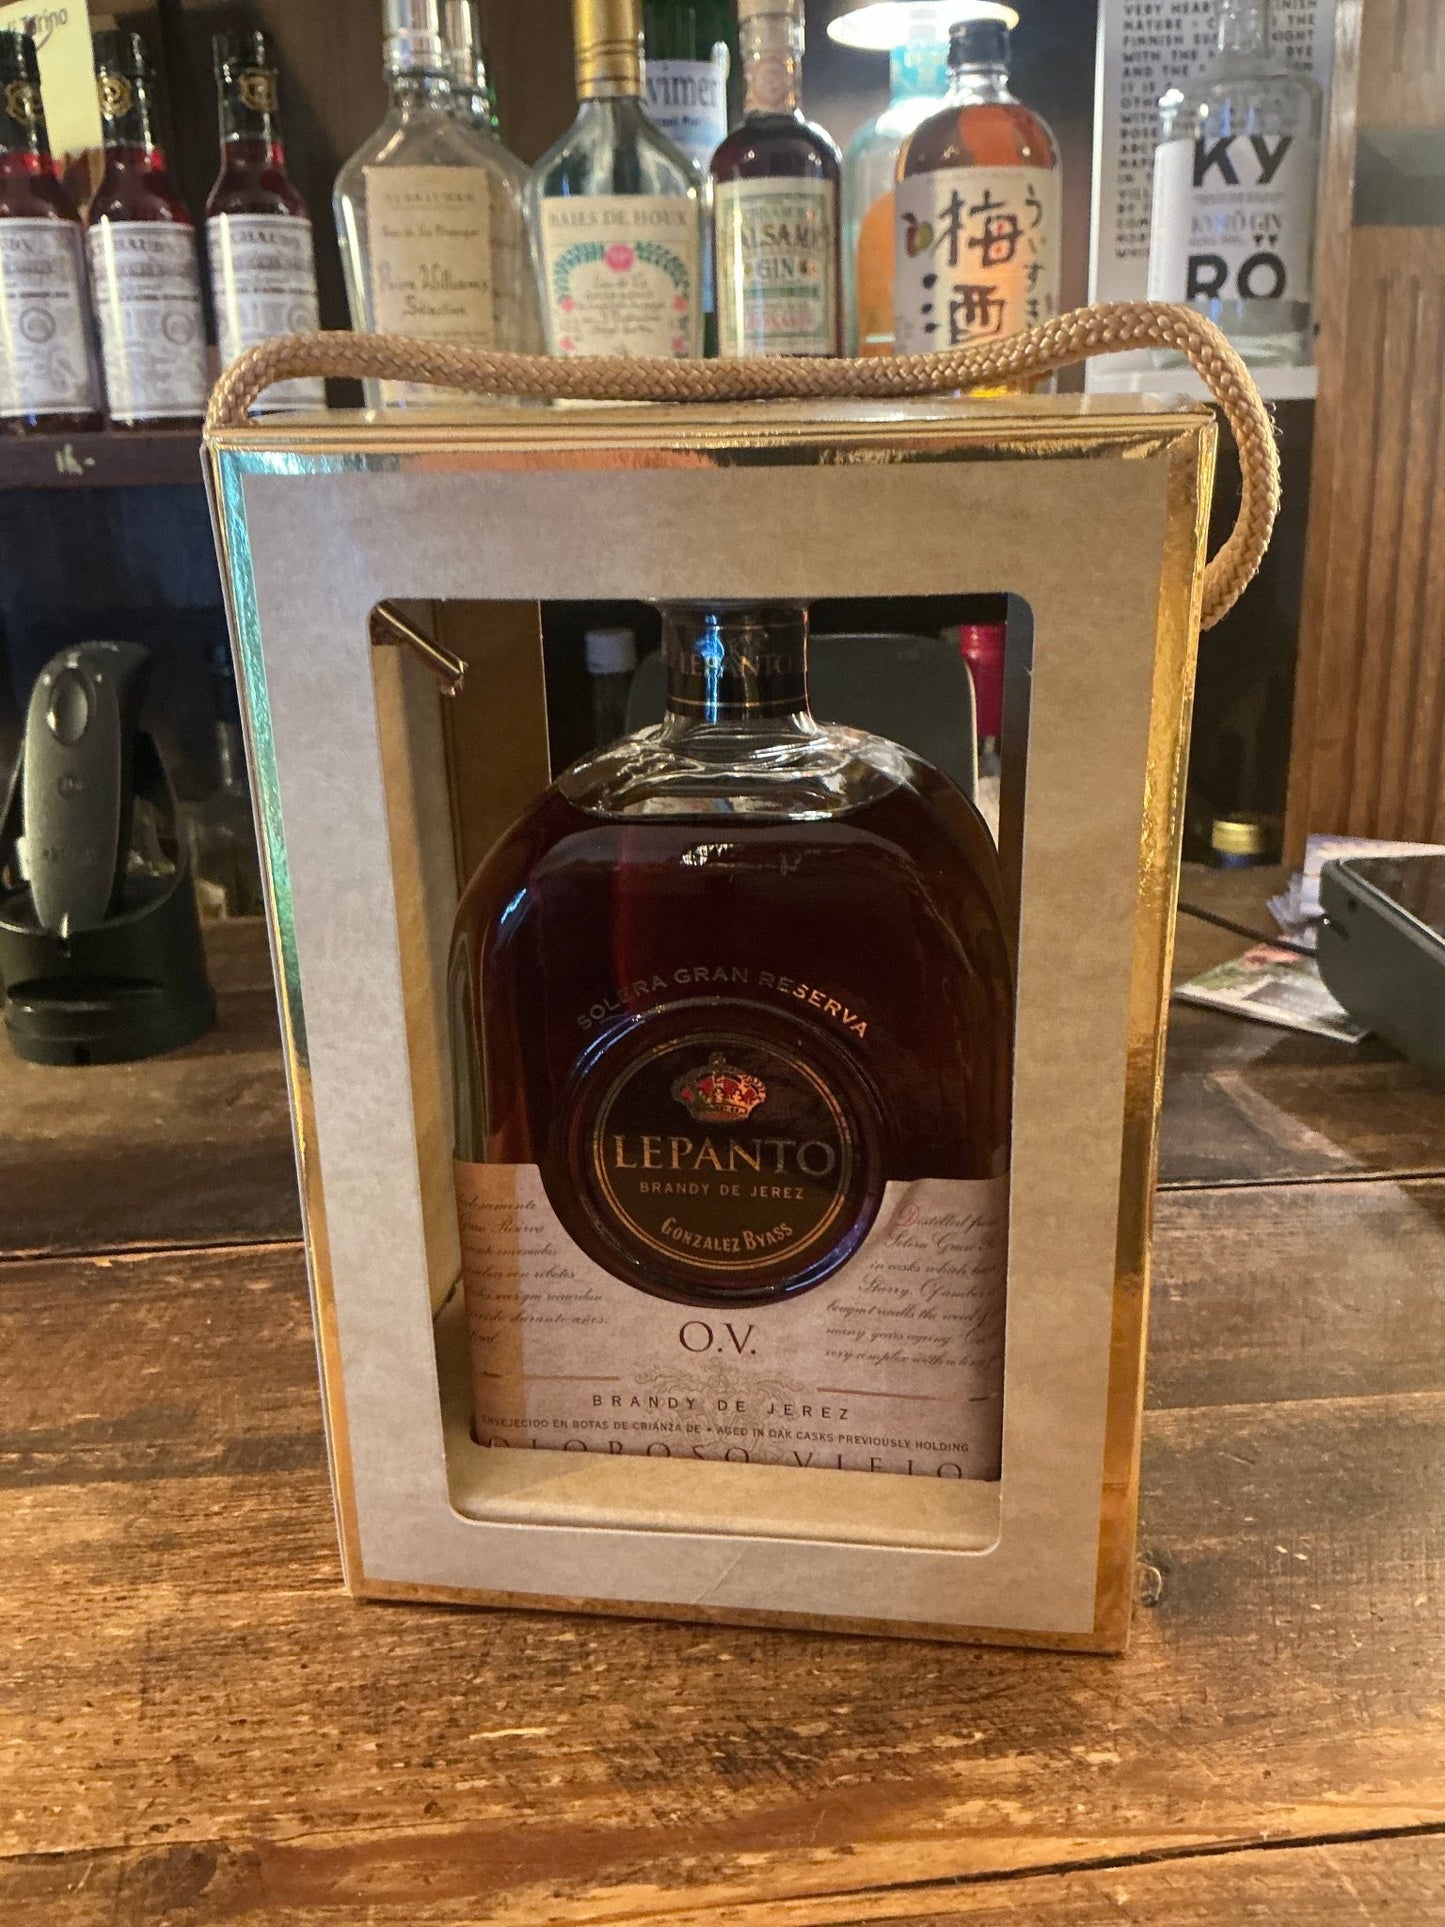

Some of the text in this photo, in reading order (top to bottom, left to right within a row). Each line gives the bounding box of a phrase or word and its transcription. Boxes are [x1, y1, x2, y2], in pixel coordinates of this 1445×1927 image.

[1124, 4, 1161, 16] VERY
[1171, 2, 1211, 14] HEAR
[1123, 19, 1182, 31] NATURE
[1122, 34, 1184, 47] FINNISH
[1123, 50, 1160, 63] WITH
[1171, 49, 1196, 61] THE
[1123, 64, 1188, 78] AND THE
[758, 258, 797, 280] GIN
[577, 966, 869, 1038] SOLERA GRAN RESERVA
[612, 1134, 836, 1177] LEPANTO
[640, 1181, 804, 1200] BRANDY DE JEREZ
[679, 1320, 756, 1355] O.V.
[592, 1395, 849, 1420] BRANDY DE JEREZ
[481, 1414, 969, 1453] ENVEJECIDO EN BOTAS DE CRIANZA DE AGED IN OAK CASKS PREVIOUSLY HOLDING
